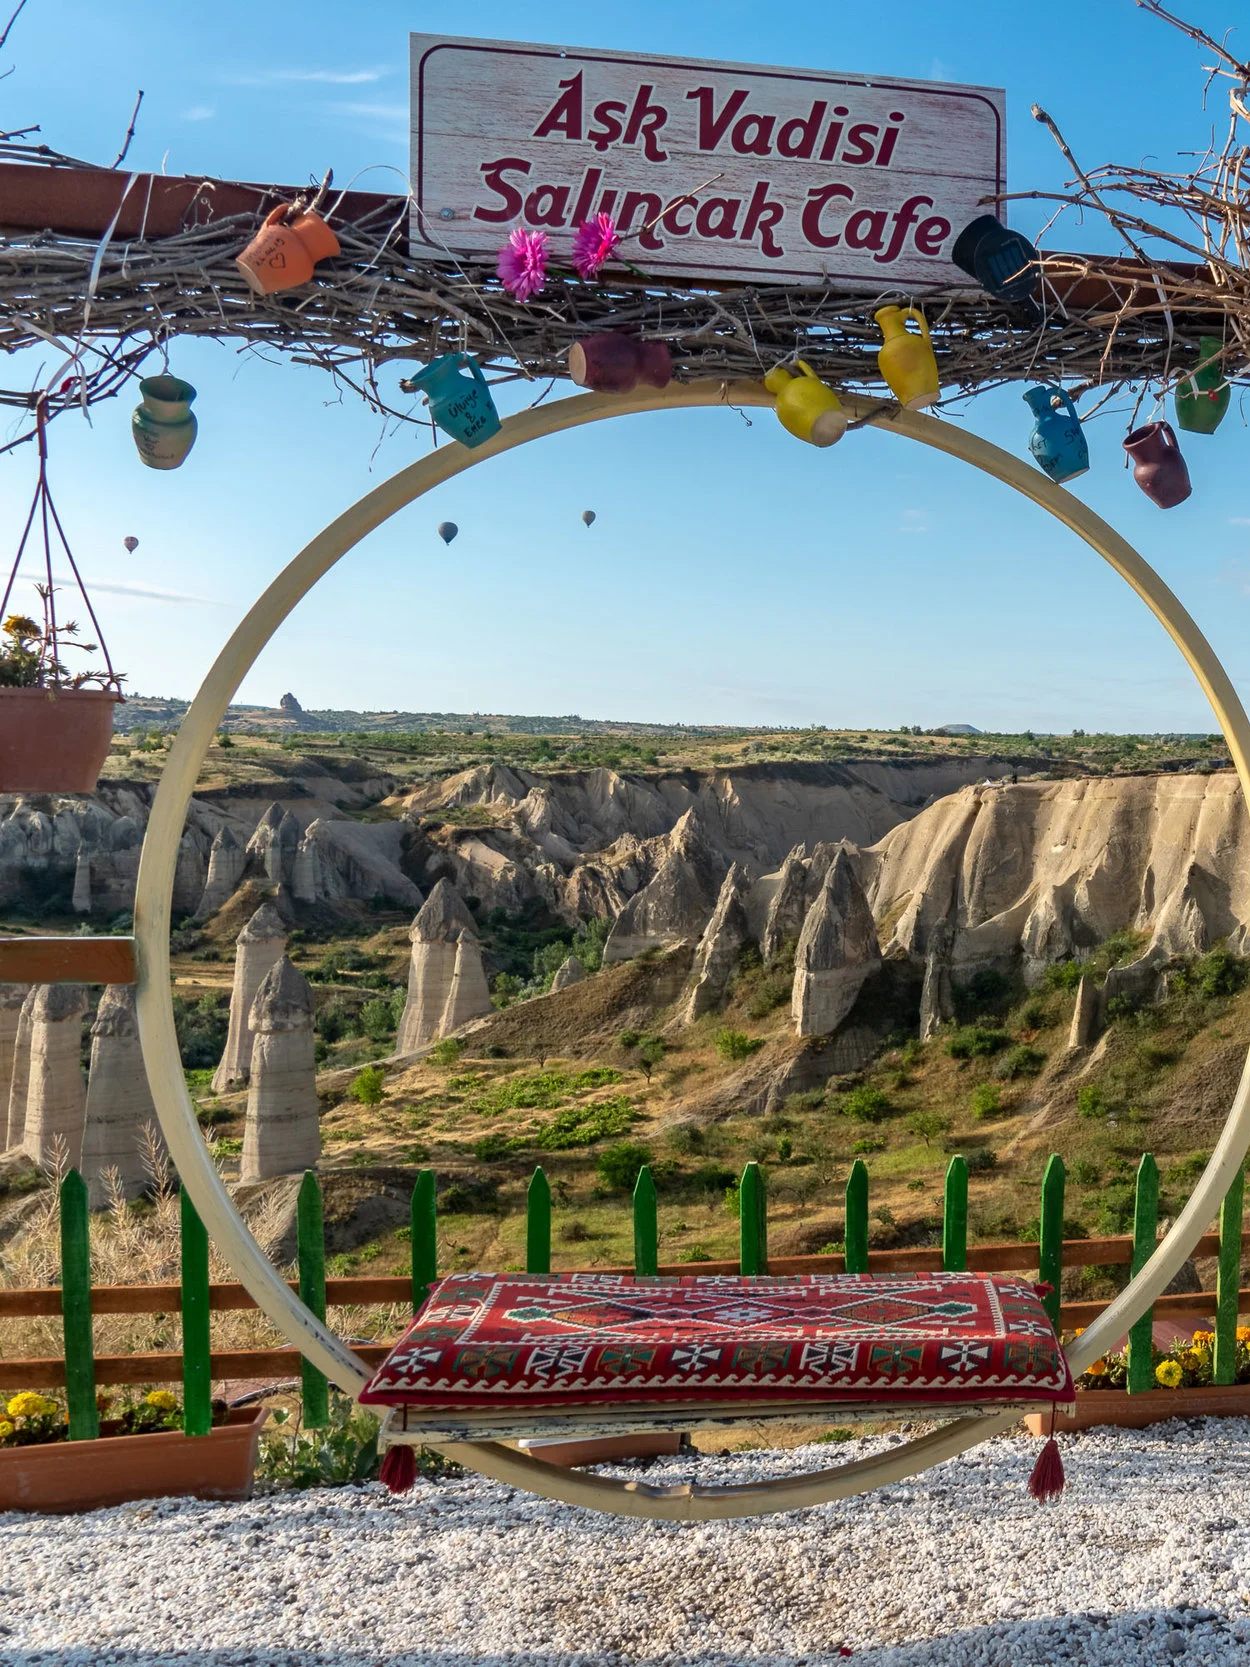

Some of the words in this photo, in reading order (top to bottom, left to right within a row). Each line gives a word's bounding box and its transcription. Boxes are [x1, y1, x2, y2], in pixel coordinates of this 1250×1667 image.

[532, 69, 668, 162] Aşk
[686, 86, 905, 166] Vadisi
[473, 157, 785, 258] Salıncak
[802, 183, 951, 263] Cafe
